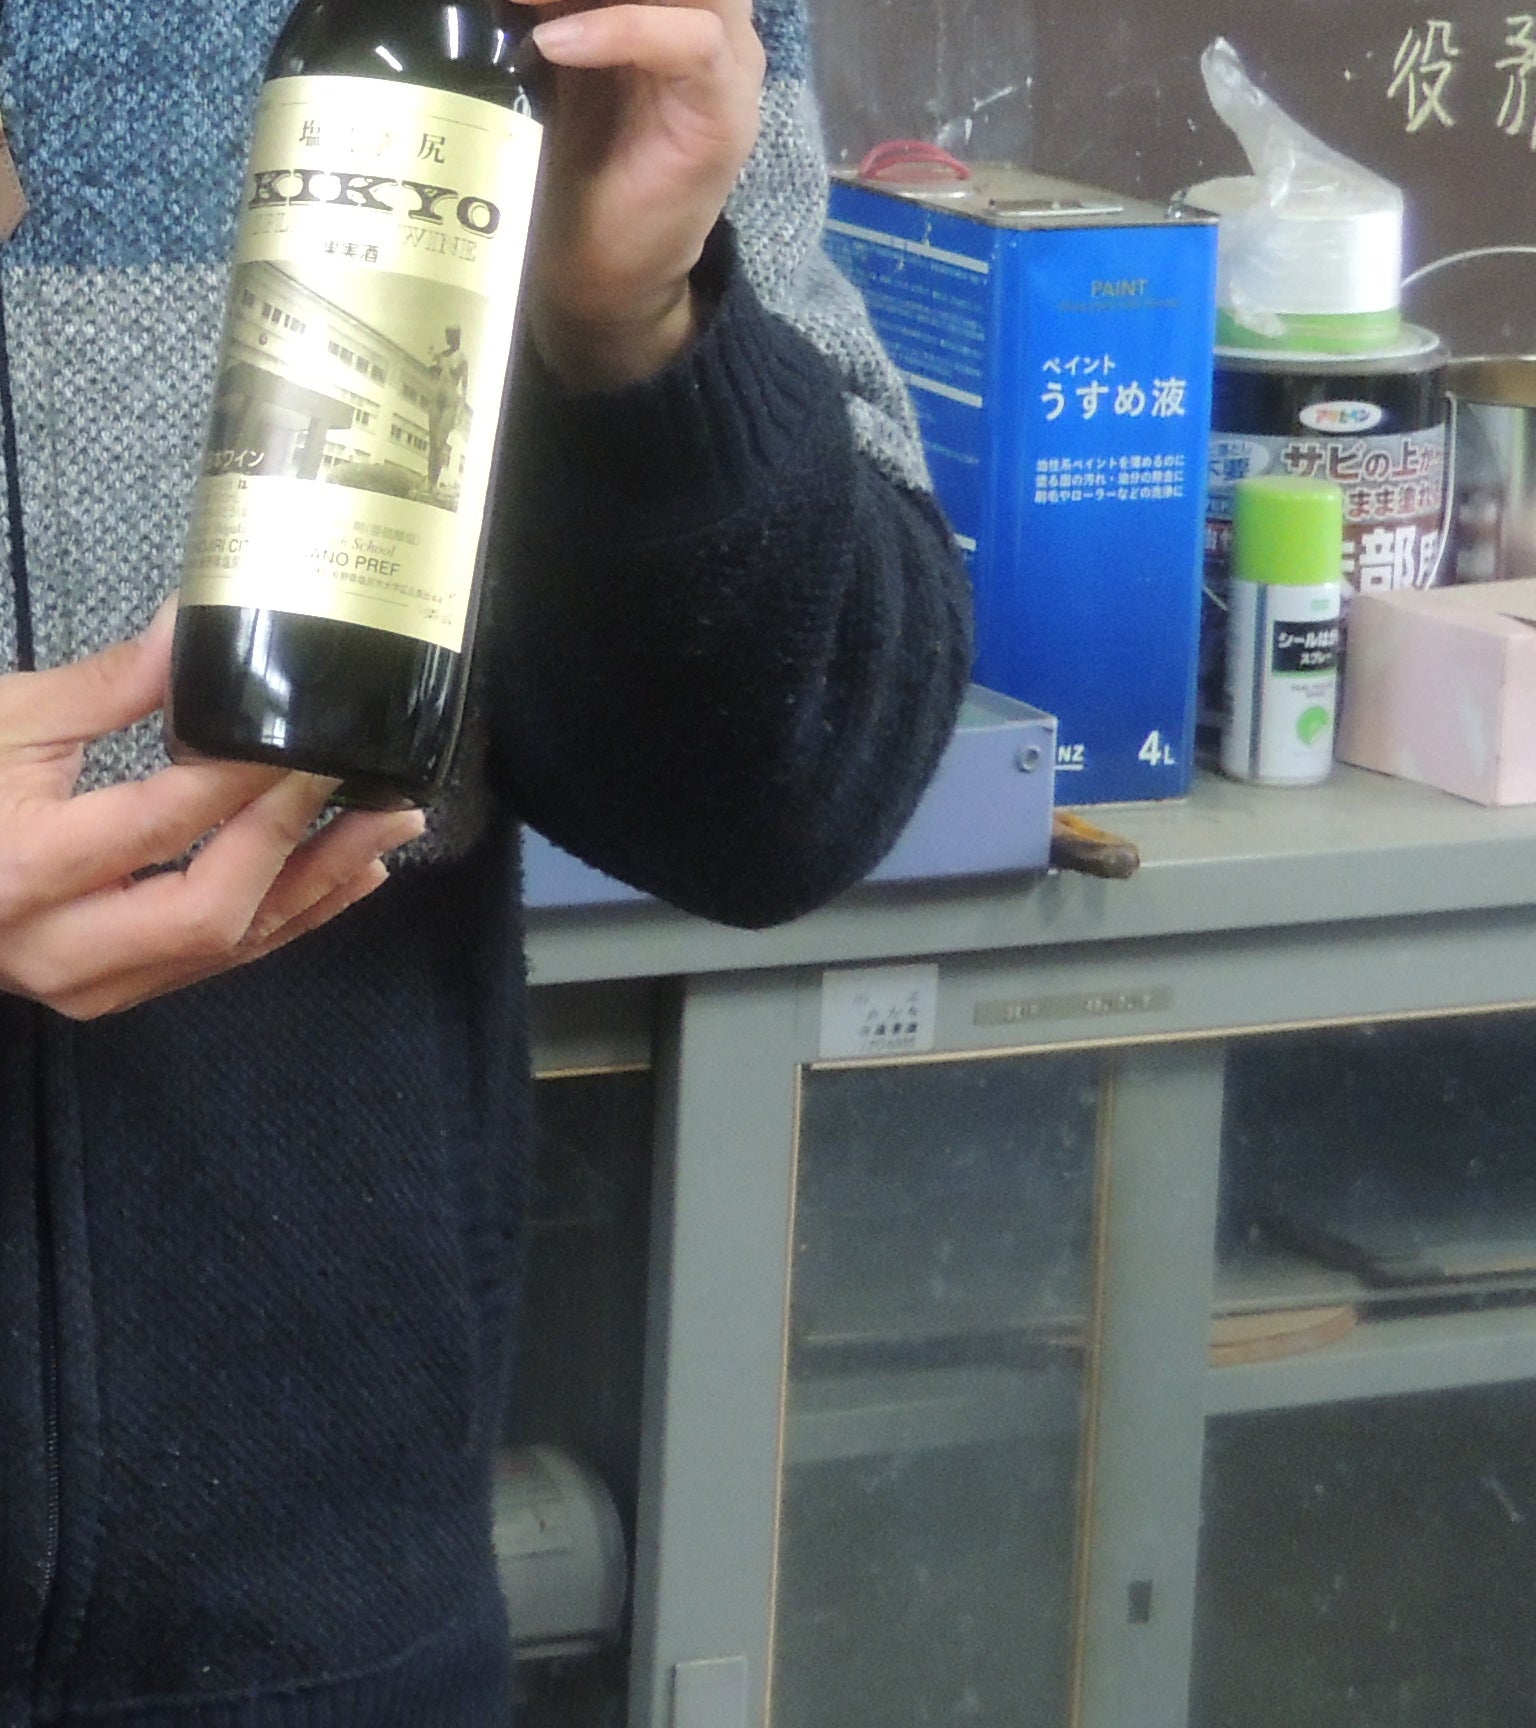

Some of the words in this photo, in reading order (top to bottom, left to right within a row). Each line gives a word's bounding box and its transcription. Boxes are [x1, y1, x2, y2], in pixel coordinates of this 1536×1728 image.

[248, 167, 502, 240] KIKYO
[400, 224, 478, 263] WINE
[1091, 279, 1148, 297] PAINT
[1042, 353, 1116, 376] ペイント
[1041, 377, 1187, 421] うすめ液
[1282, 437, 1444, 481] サビの上か
[355, 555, 401, 576] PREF
